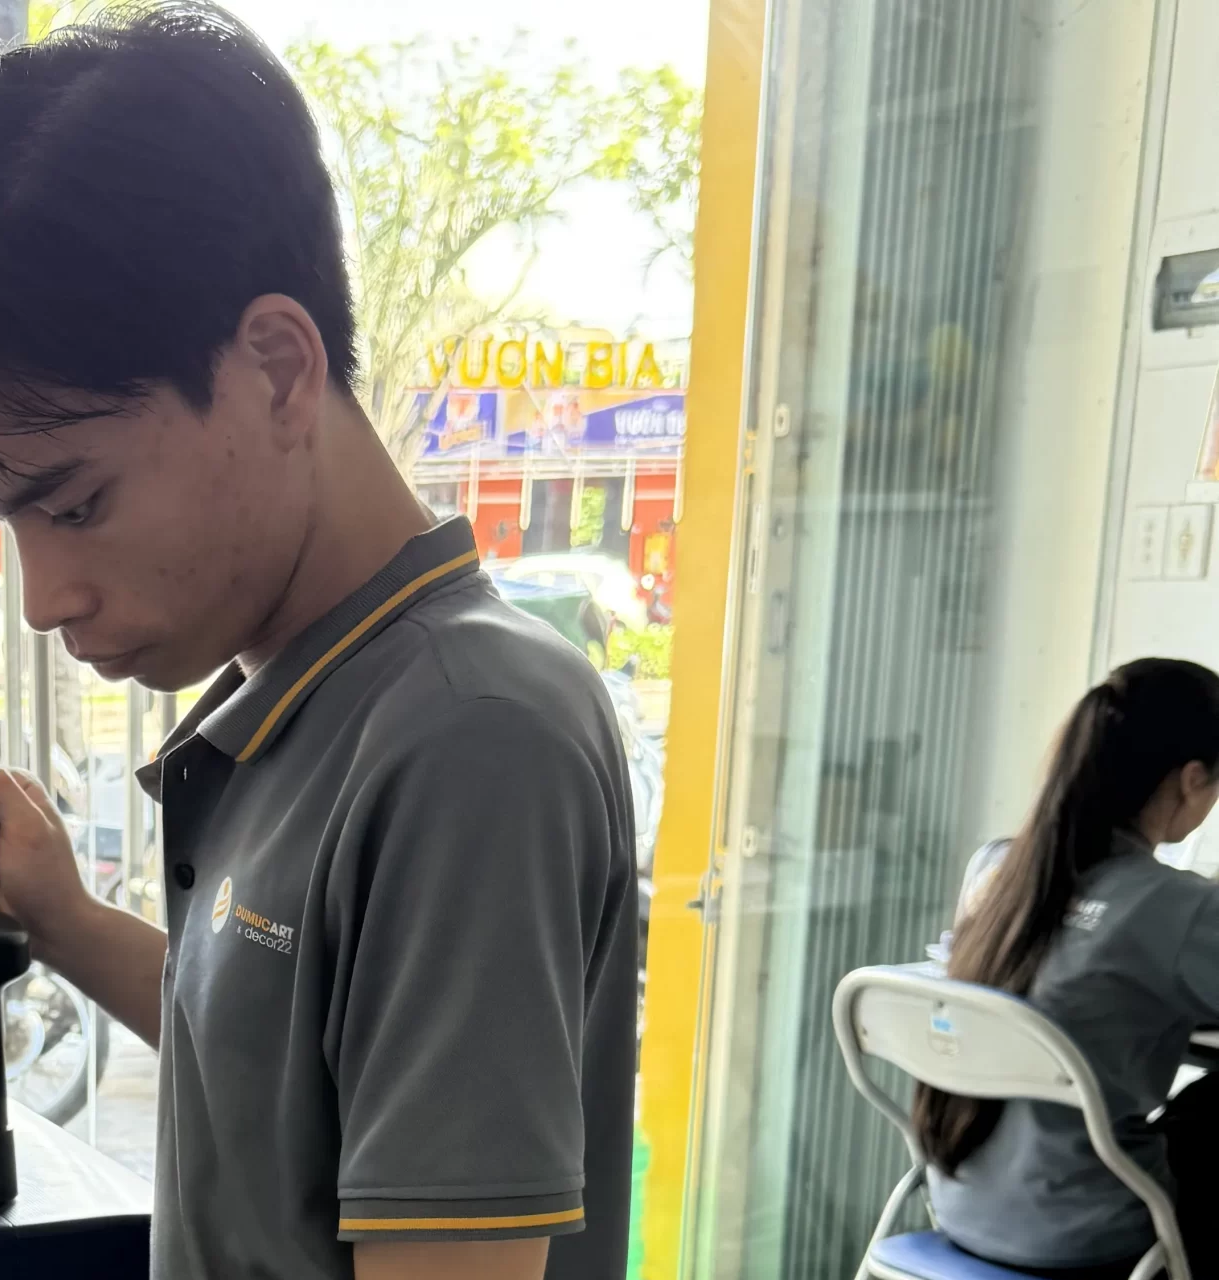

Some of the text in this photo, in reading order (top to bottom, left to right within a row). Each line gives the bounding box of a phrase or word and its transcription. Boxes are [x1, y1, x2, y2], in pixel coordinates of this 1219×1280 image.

[584, 341, 666, 389] BIA
[235, 904, 294, 940] DUMUCART
[244, 927, 292, 954] decor22
